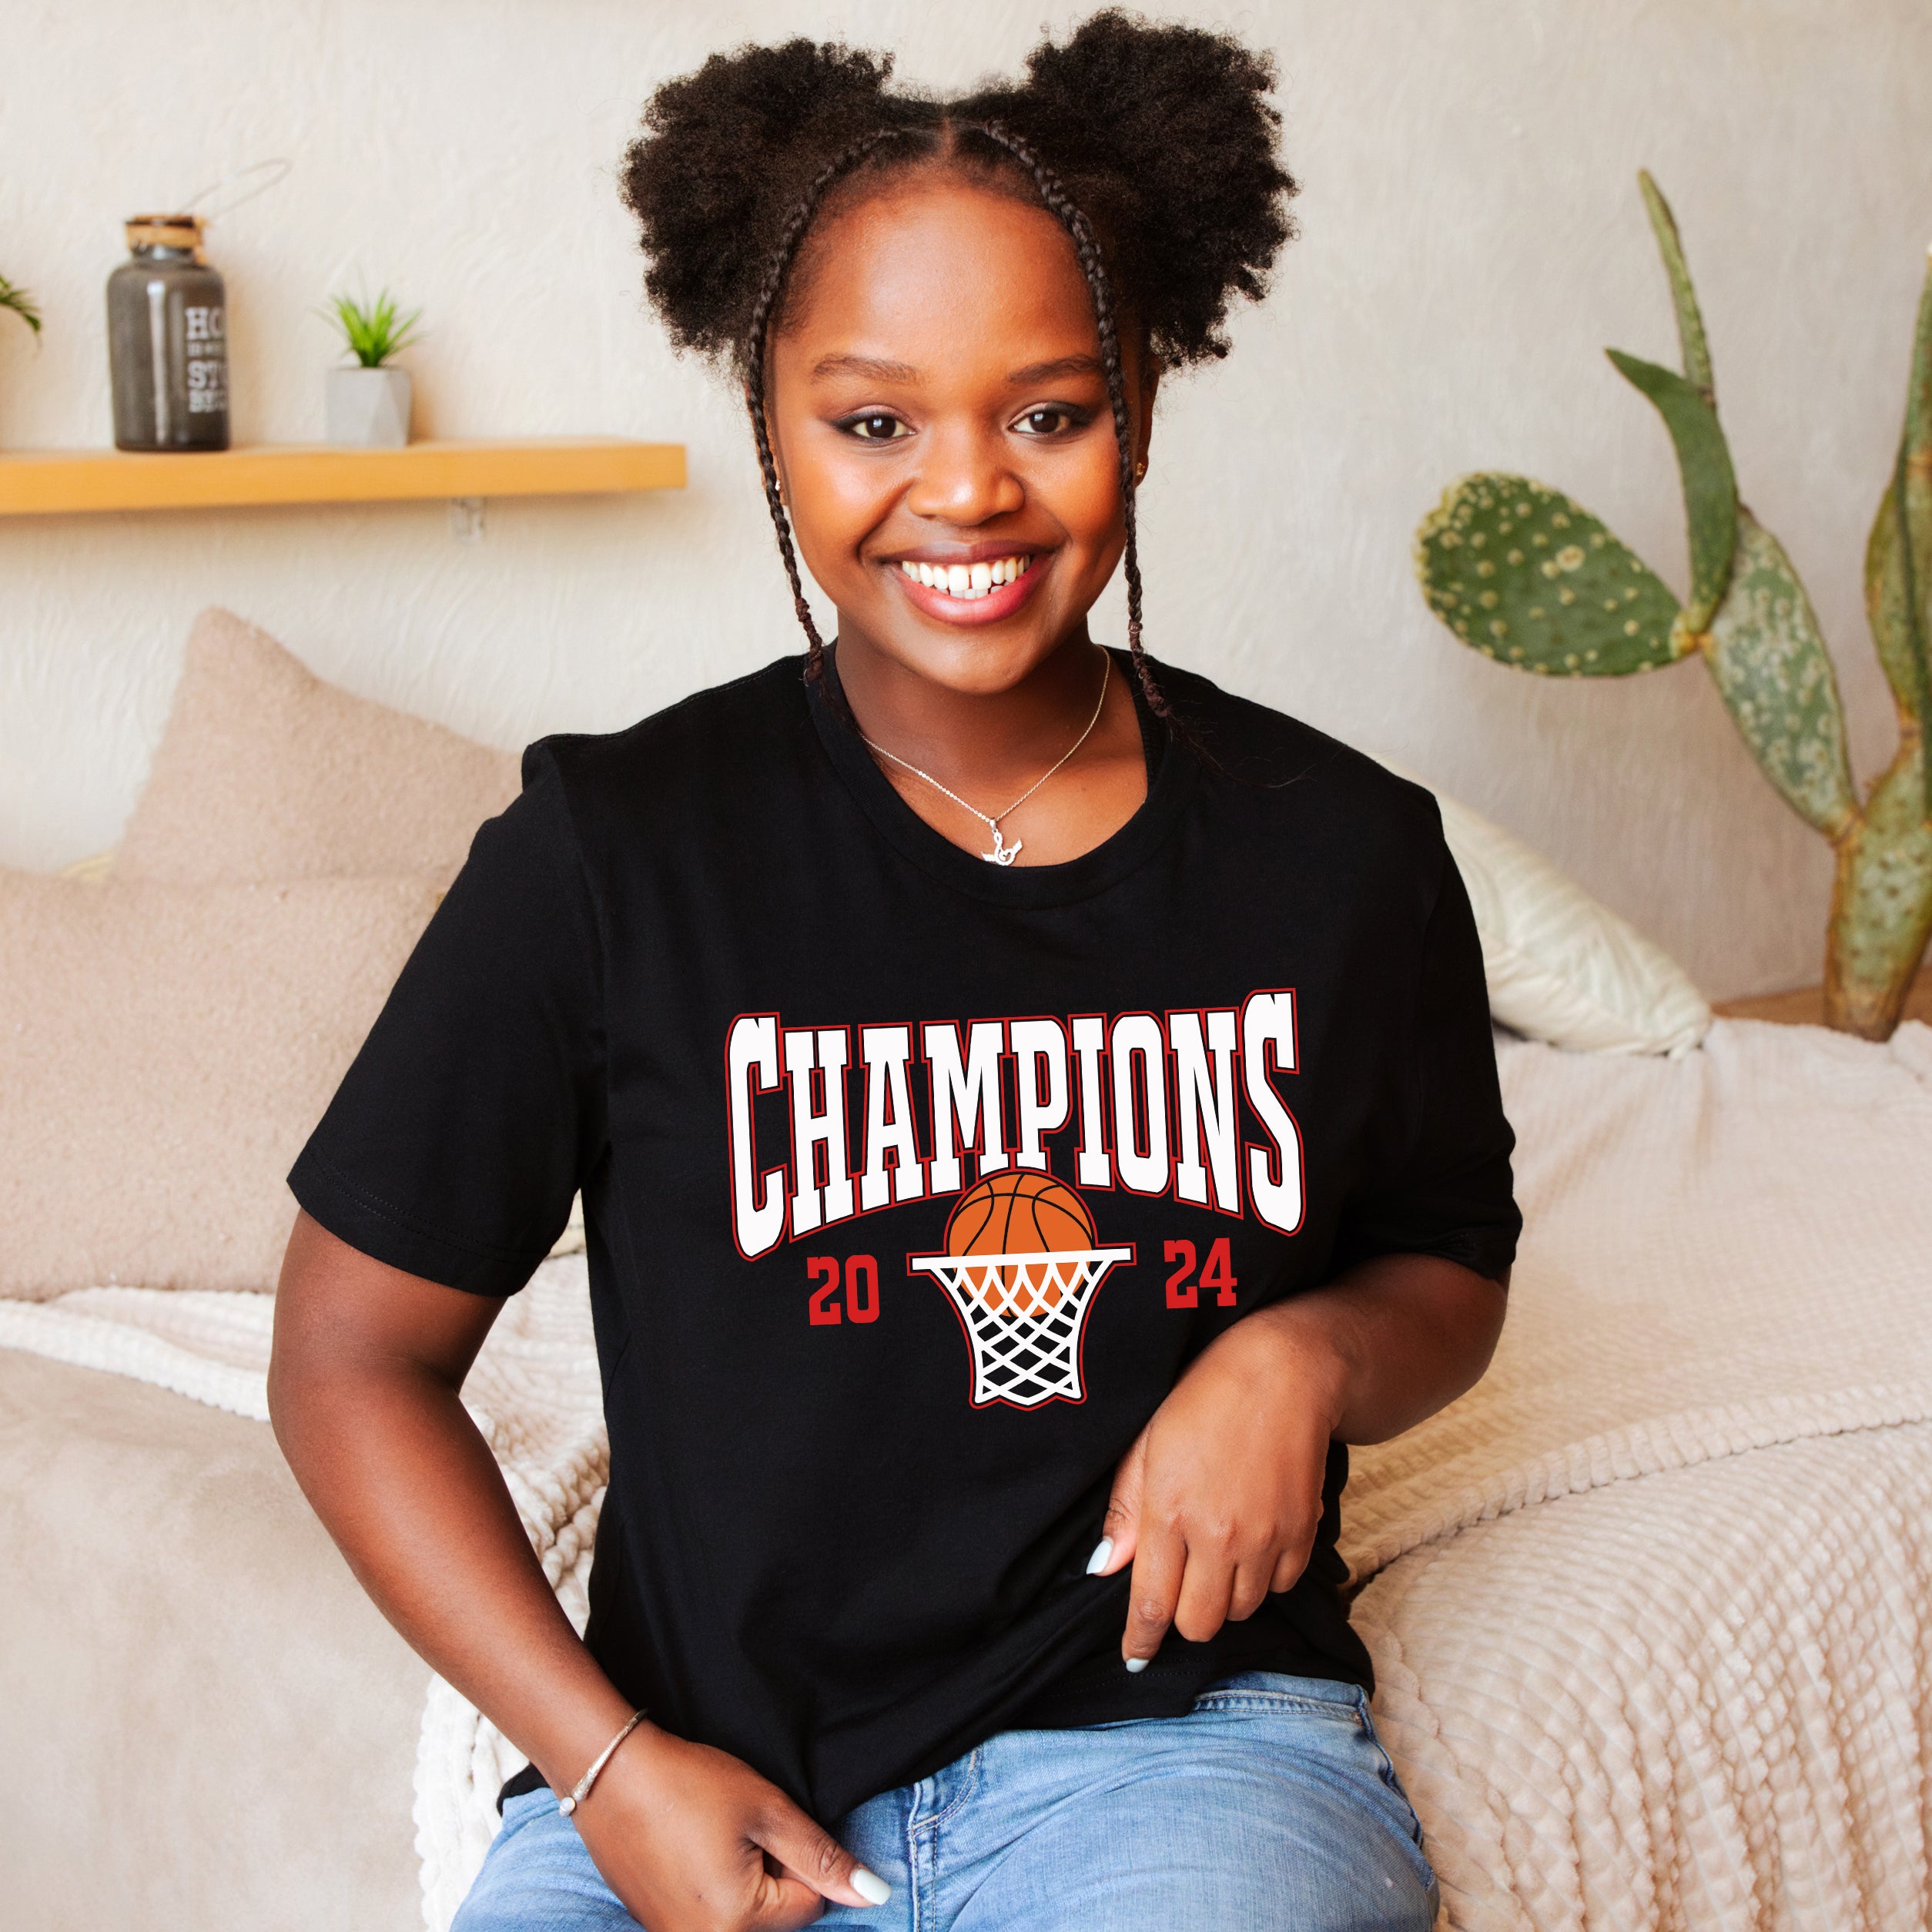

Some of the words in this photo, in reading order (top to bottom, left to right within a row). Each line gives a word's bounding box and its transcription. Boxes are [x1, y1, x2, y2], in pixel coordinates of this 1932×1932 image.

[725, 988, 1306, 1261] CHAMPIONS
[807, 1254, 879, 1325] 20
[1164, 1237, 1237, 1309] 24
